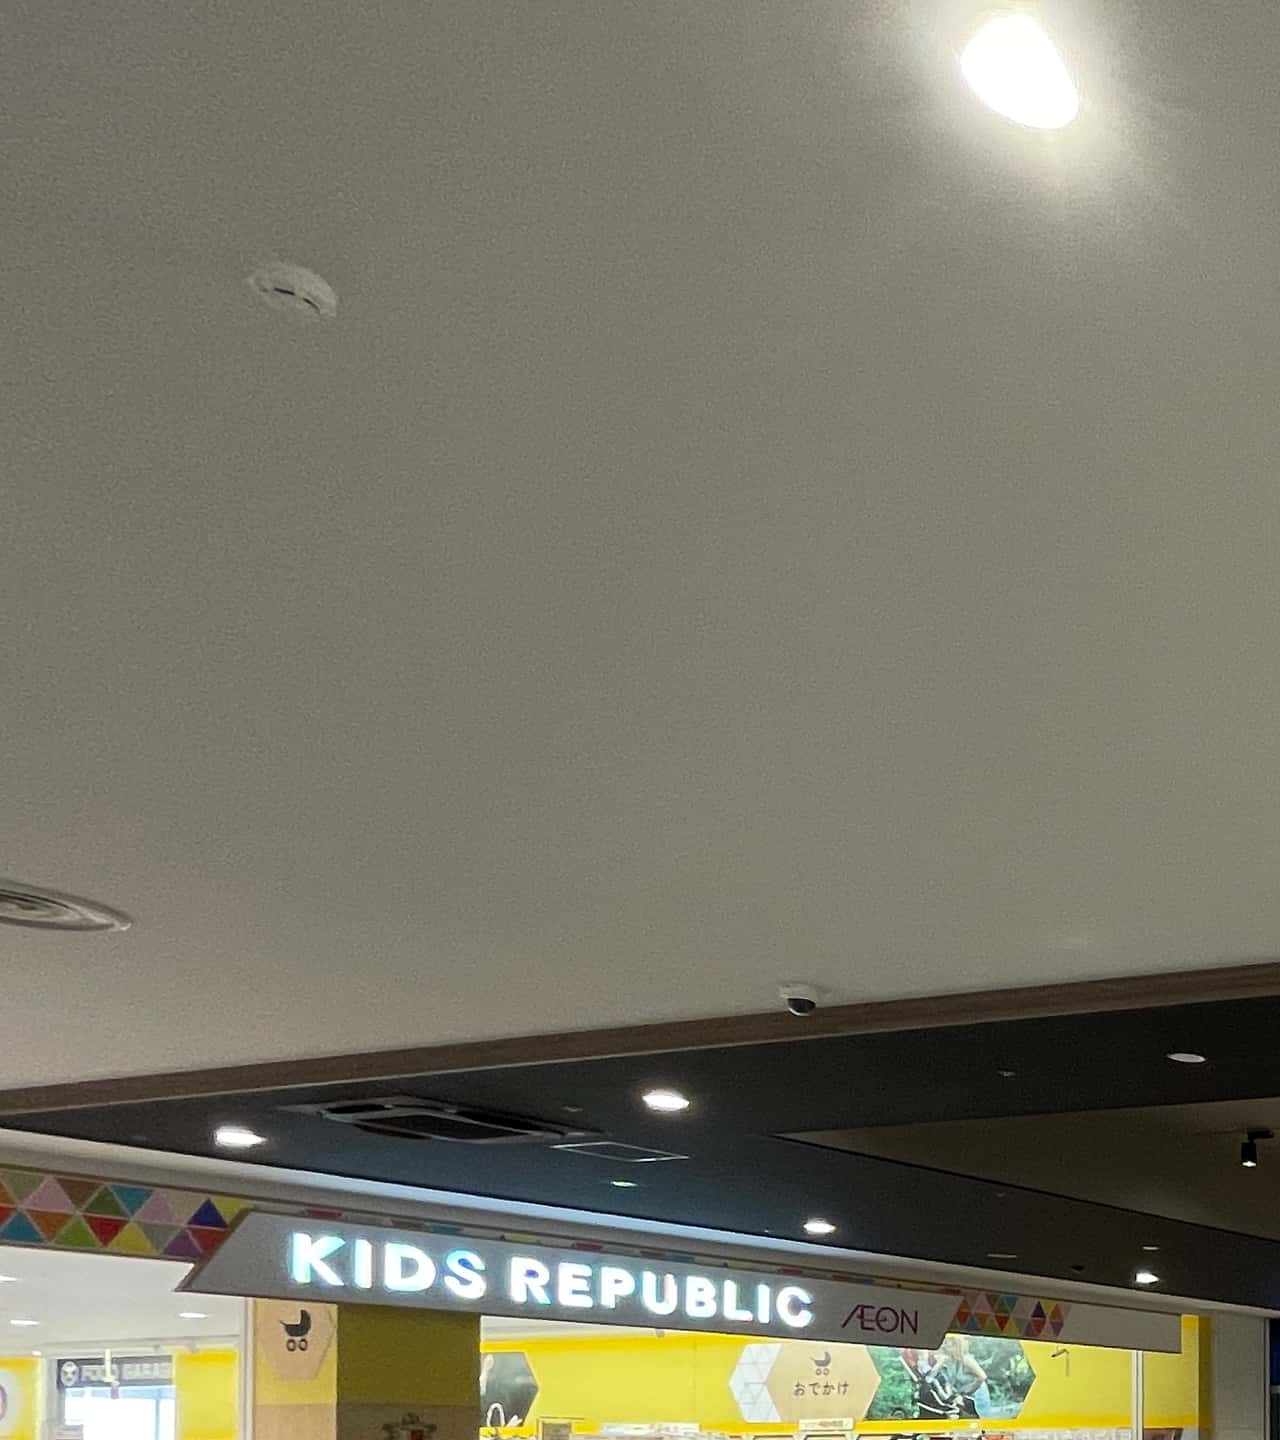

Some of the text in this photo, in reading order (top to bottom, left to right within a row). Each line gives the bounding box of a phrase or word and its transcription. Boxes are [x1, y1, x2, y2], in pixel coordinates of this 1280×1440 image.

[288, 1231, 815, 1329] KIDS REPUBLIC
[793, 1381, 849, 1396] おでかけ
